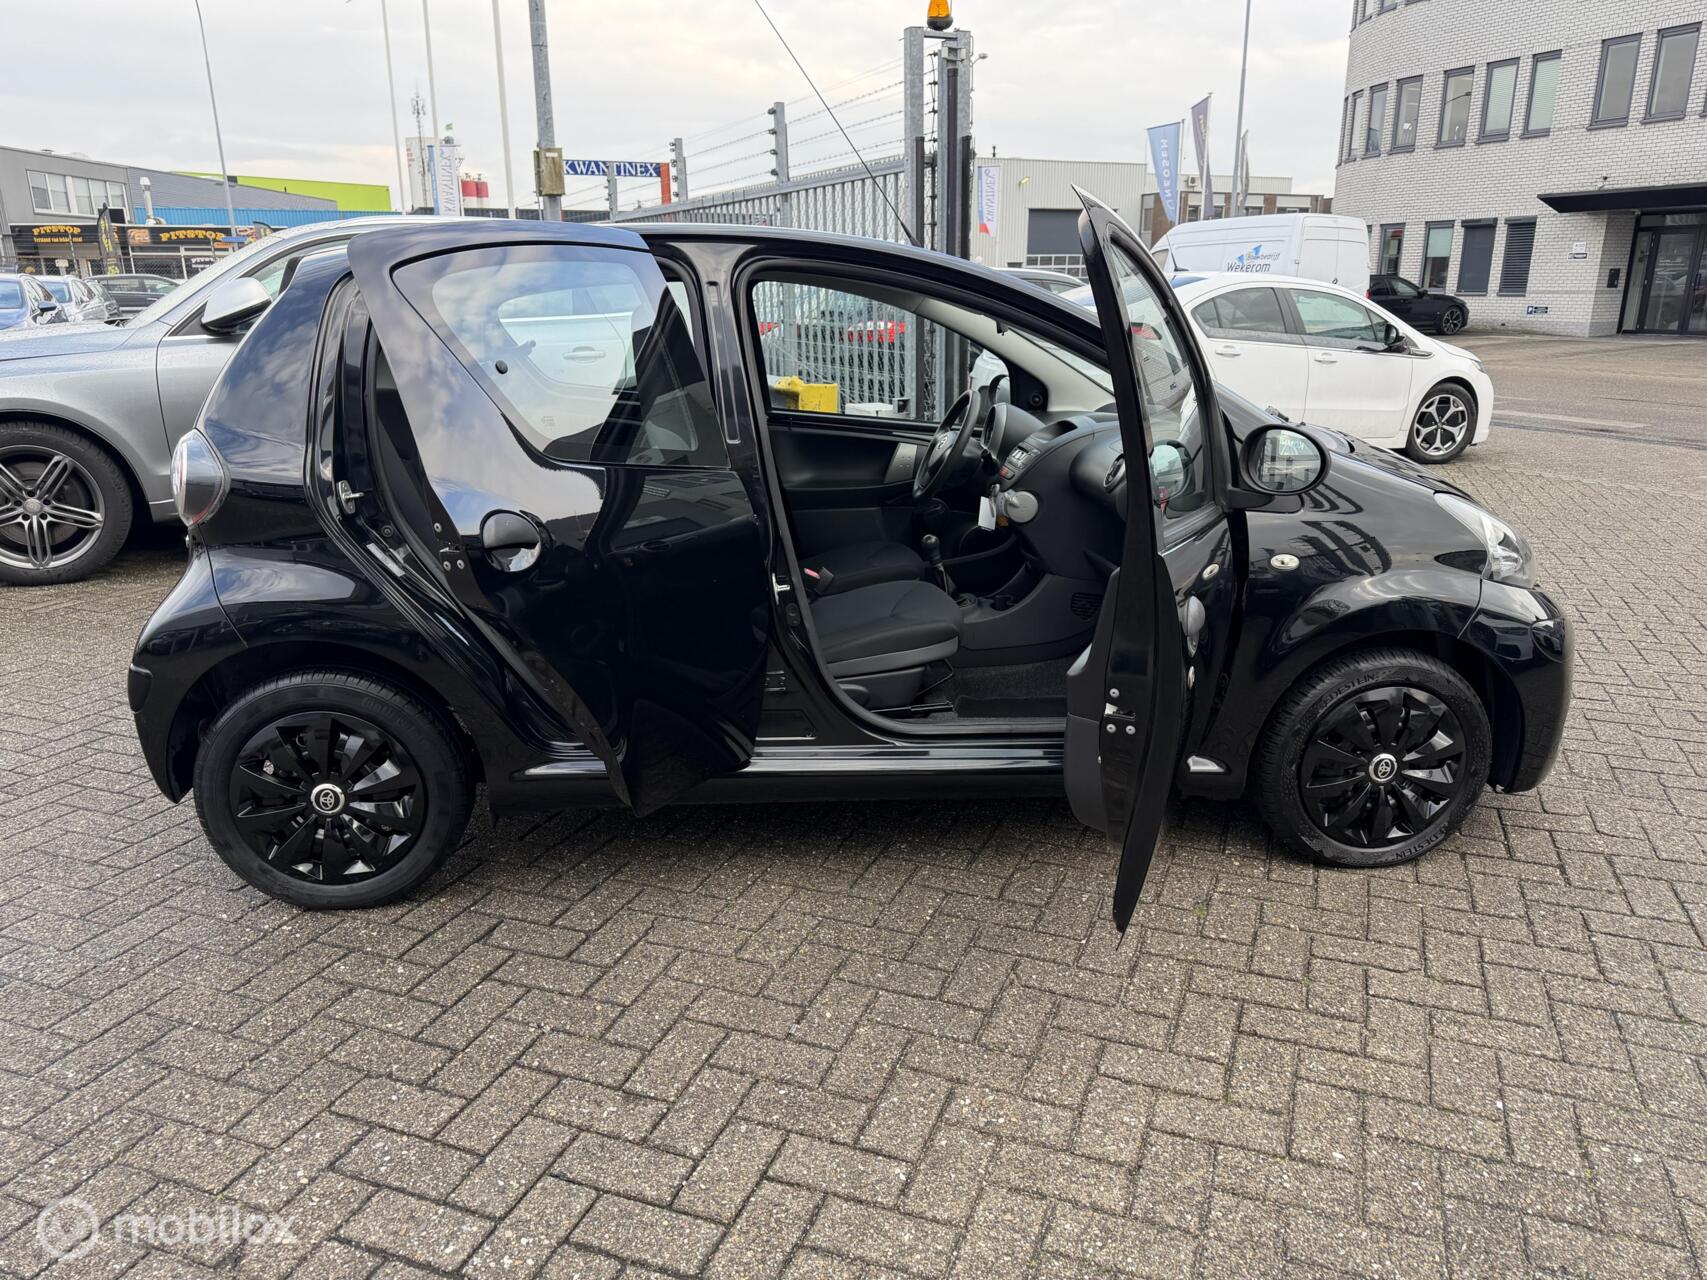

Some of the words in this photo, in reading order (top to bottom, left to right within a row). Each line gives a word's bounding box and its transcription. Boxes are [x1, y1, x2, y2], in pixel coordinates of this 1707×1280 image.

[563, 160, 658, 176] KWANTINEX
[32, 225, 81, 235] PITSTOP
[160, 229, 225, 241] PITSTOP
[1226, 261, 1271, 272] Wekerom
